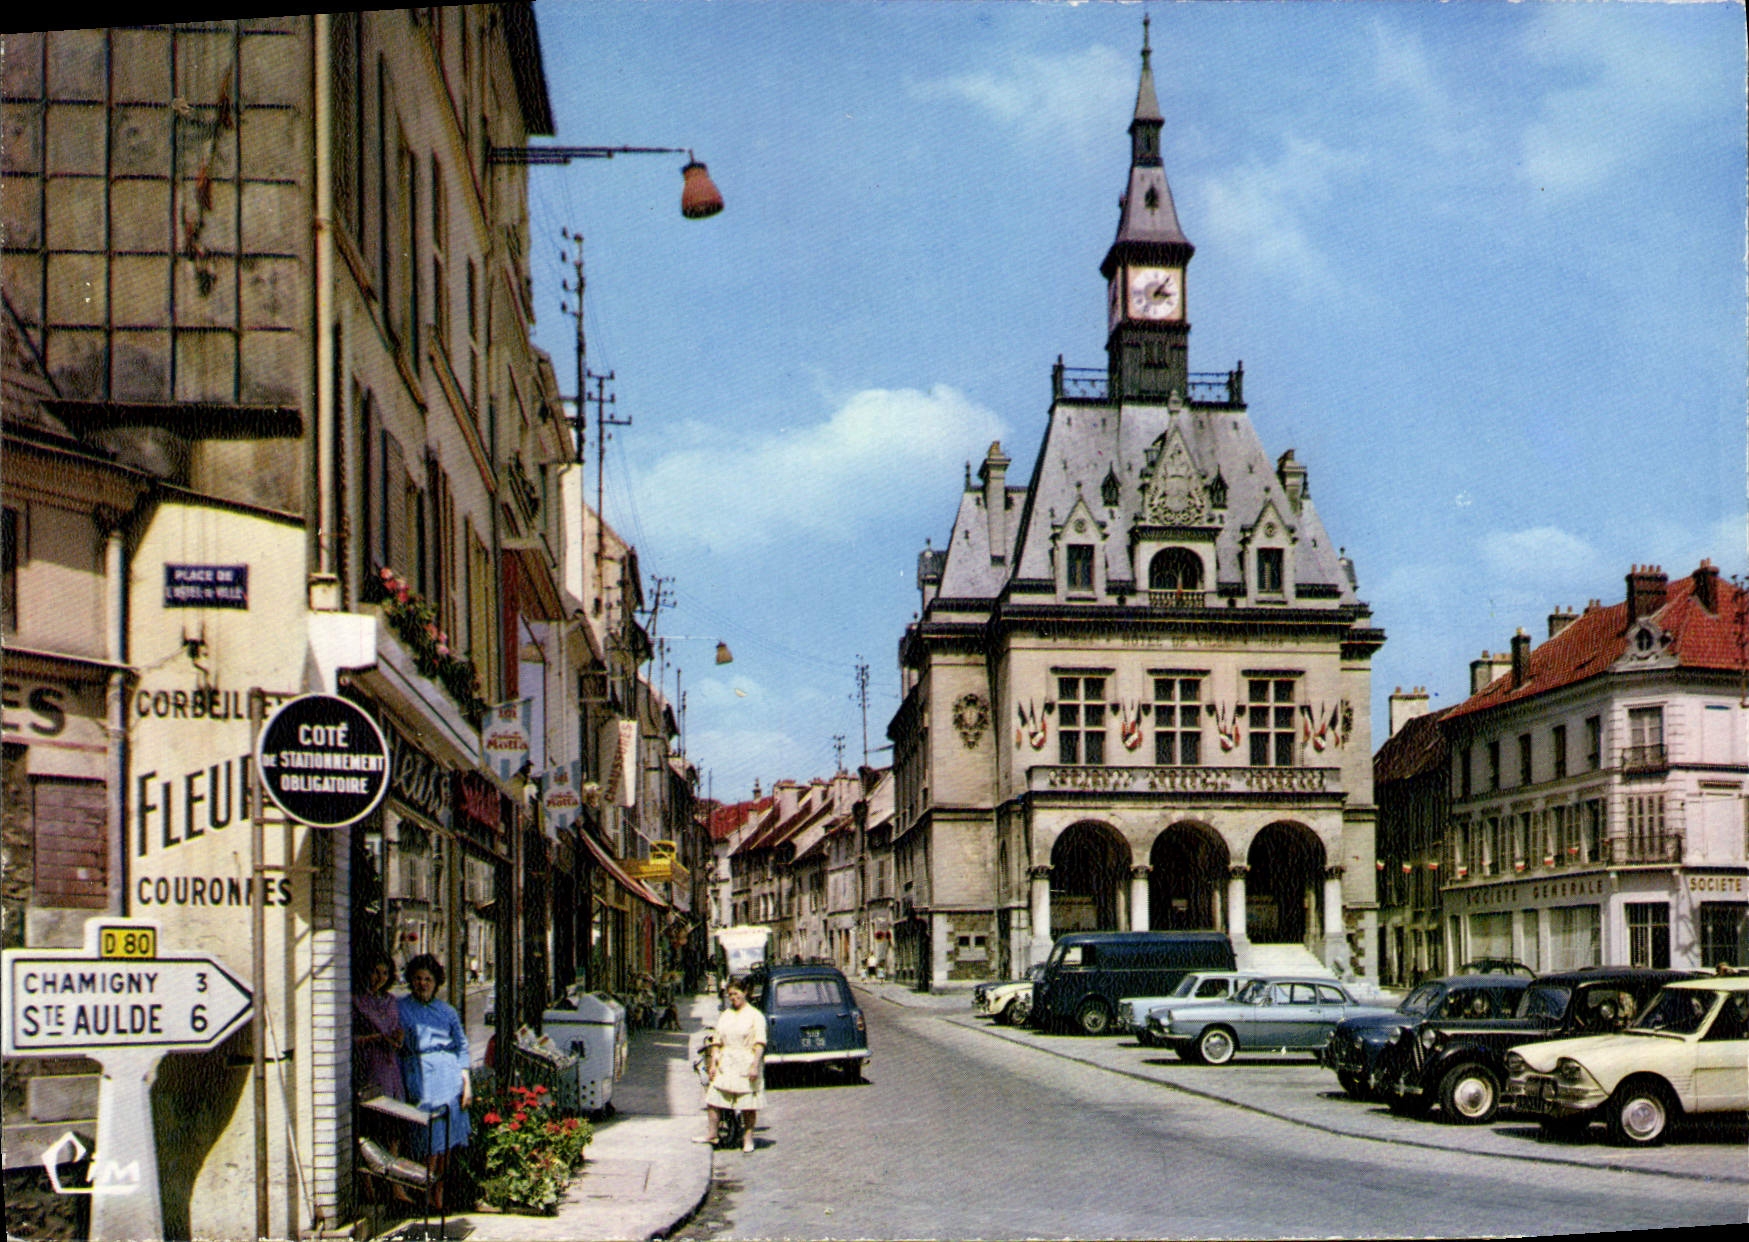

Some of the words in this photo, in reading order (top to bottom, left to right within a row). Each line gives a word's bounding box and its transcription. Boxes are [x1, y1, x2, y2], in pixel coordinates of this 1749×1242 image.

[173, 570, 213, 582] PLACE
[216, 570, 234, 582] DE
[280, 751, 384, 771] STATIONNEMENT
[280, 774, 369, 794] OBLIGATOIRE
[1690, 877, 1742, 891] SOCIETE
[104, 932, 116, 954] D
[123, 932, 150, 955] 80
[24, 972, 158, 994] CHAMIGNY
[195, 972, 209, 993] 3
[74, 1004, 163, 1034] AULDE
[191, 1004, 208, 1033] 6
